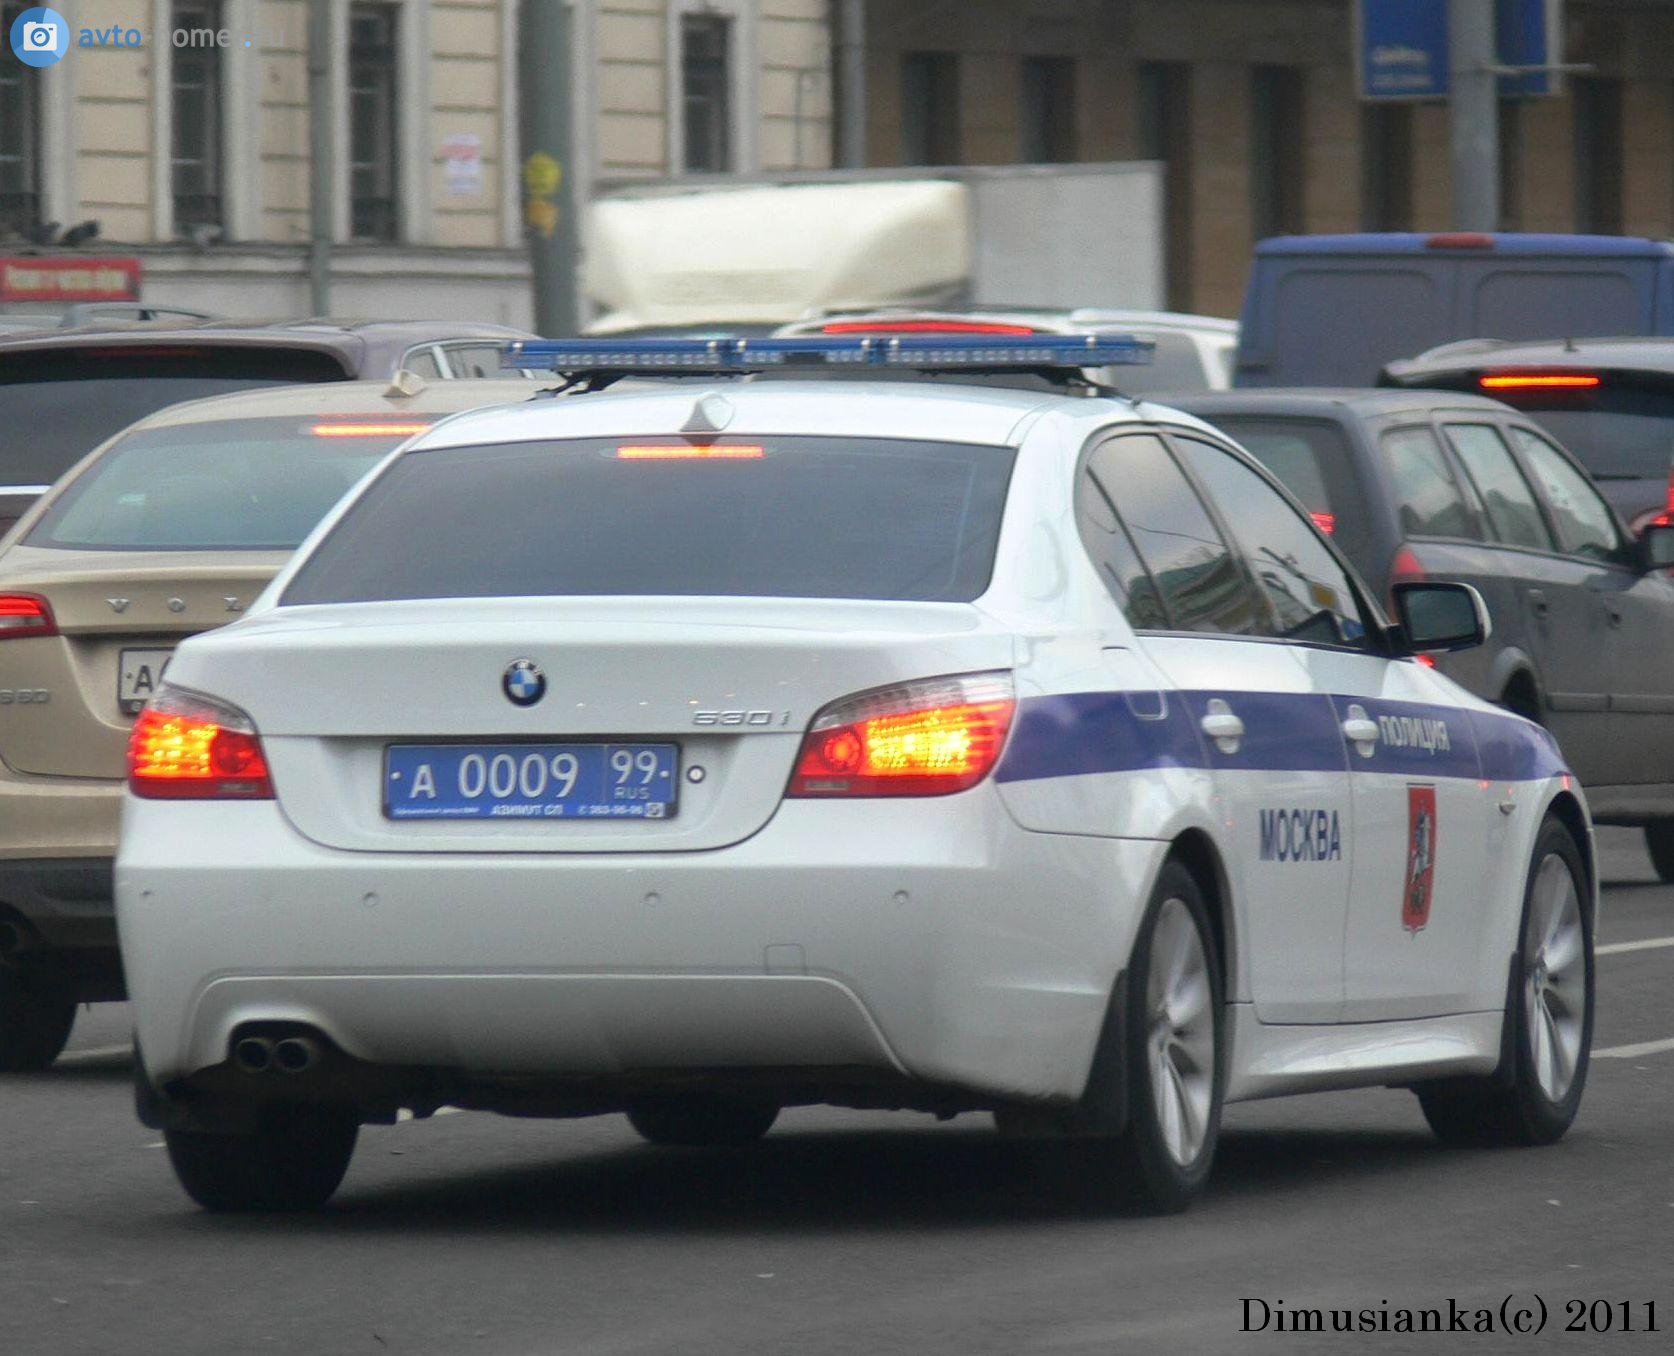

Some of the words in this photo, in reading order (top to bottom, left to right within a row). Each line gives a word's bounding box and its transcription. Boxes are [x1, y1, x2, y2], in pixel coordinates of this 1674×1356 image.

[1379, 715, 1450, 755] ПОЛИЦИЯ
[458, 753, 579, 798] 0009
[610, 750, 658, 784] 99
[614, 786, 651, 800] RUS
[1259, 809, 1341, 862] МОСКВА
